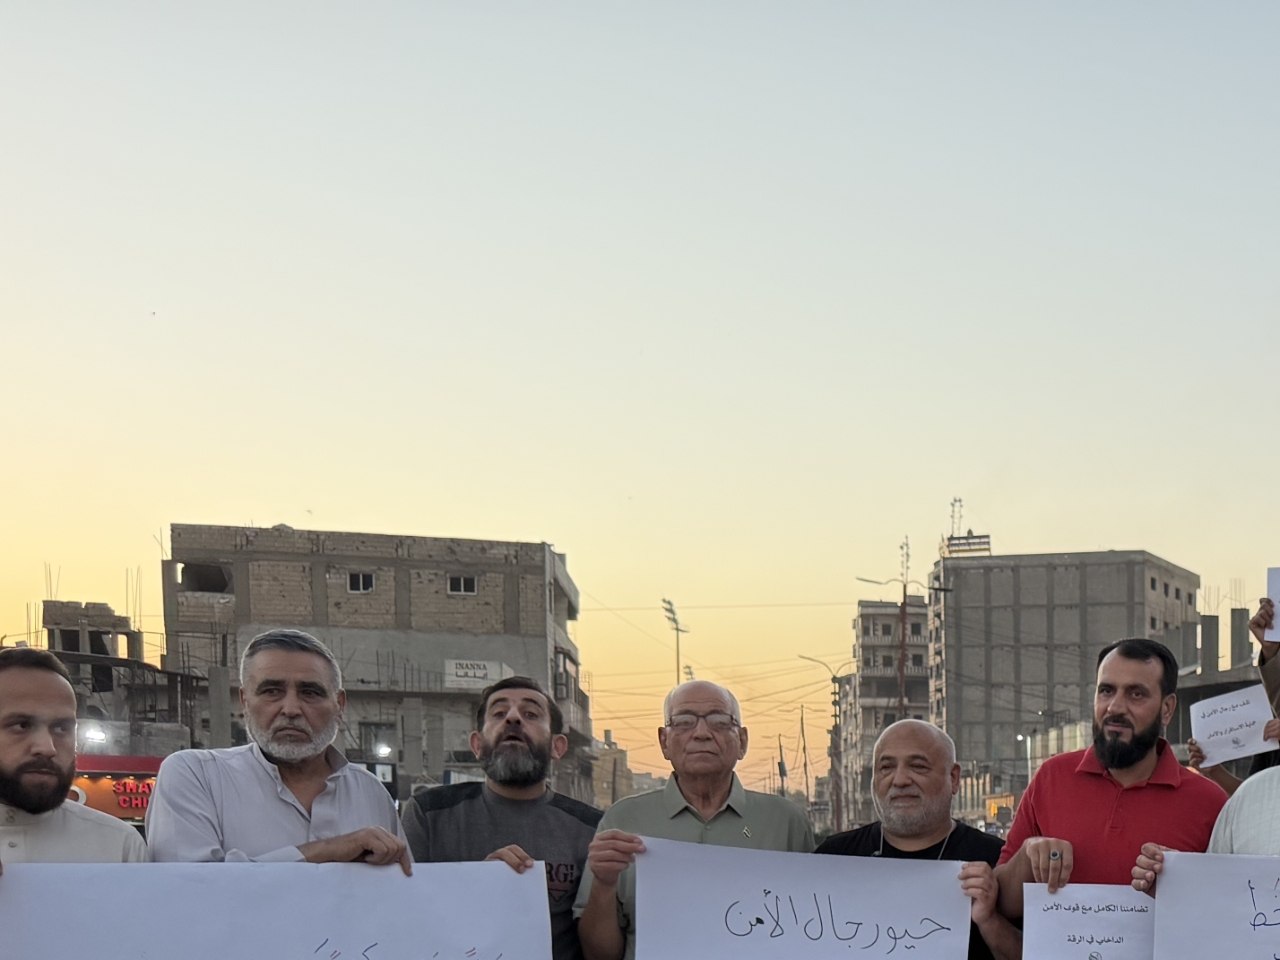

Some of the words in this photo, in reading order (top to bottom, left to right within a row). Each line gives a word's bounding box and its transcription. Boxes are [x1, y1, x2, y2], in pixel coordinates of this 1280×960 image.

[1043, 902, 1062, 912] الأمن
[1064, 903, 1080, 914] قوى
[1081, 906, 1092, 914] مع
[1094, 904, 1118, 913] الكامل
[1120, 904, 1149, 913] تضامننا
[724, 888, 798, 939] الأمن
[1067, 934, 1084, 944] الرقة
[1086, 934, 1094, 944] في
[1095, 936, 1124, 945] الداخلي
